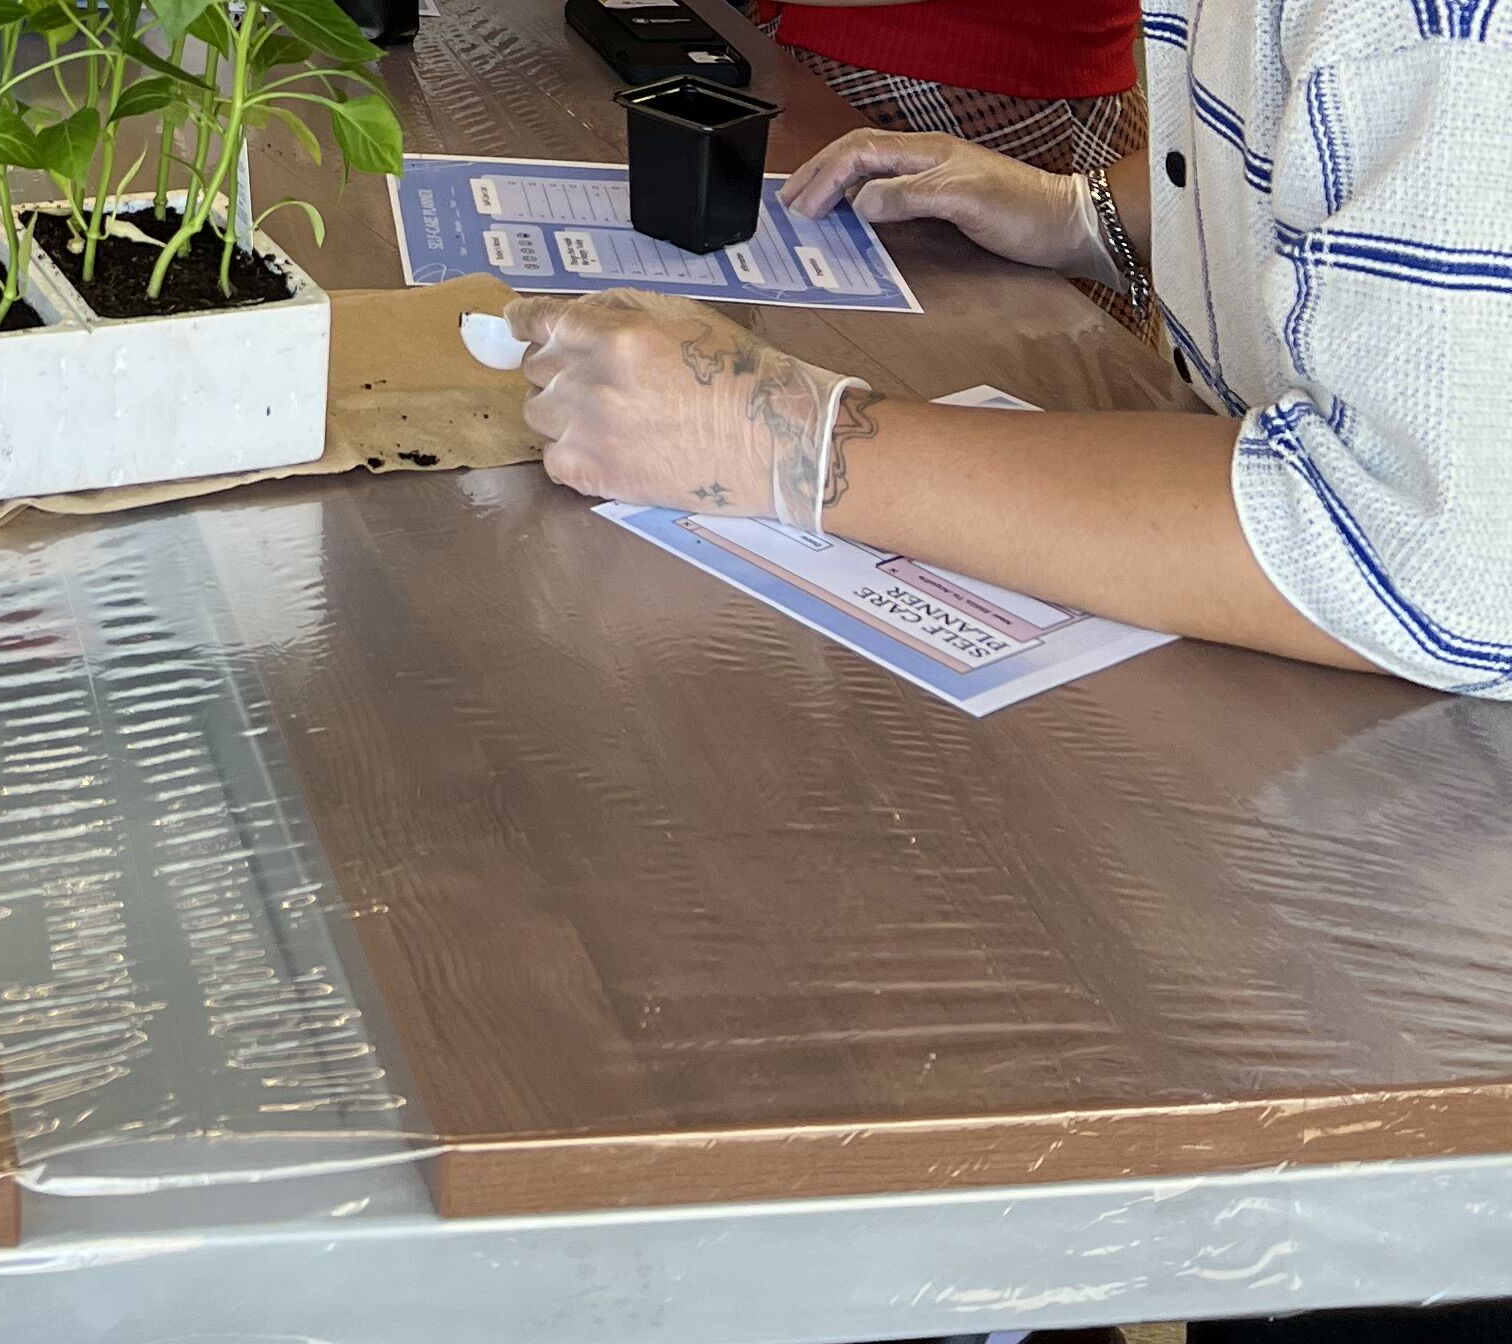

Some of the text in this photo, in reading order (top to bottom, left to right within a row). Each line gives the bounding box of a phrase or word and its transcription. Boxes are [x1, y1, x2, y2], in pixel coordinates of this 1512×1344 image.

[853, 586, 991, 658] SELF CARE
[887, 586, 1012, 651] PLANNER
